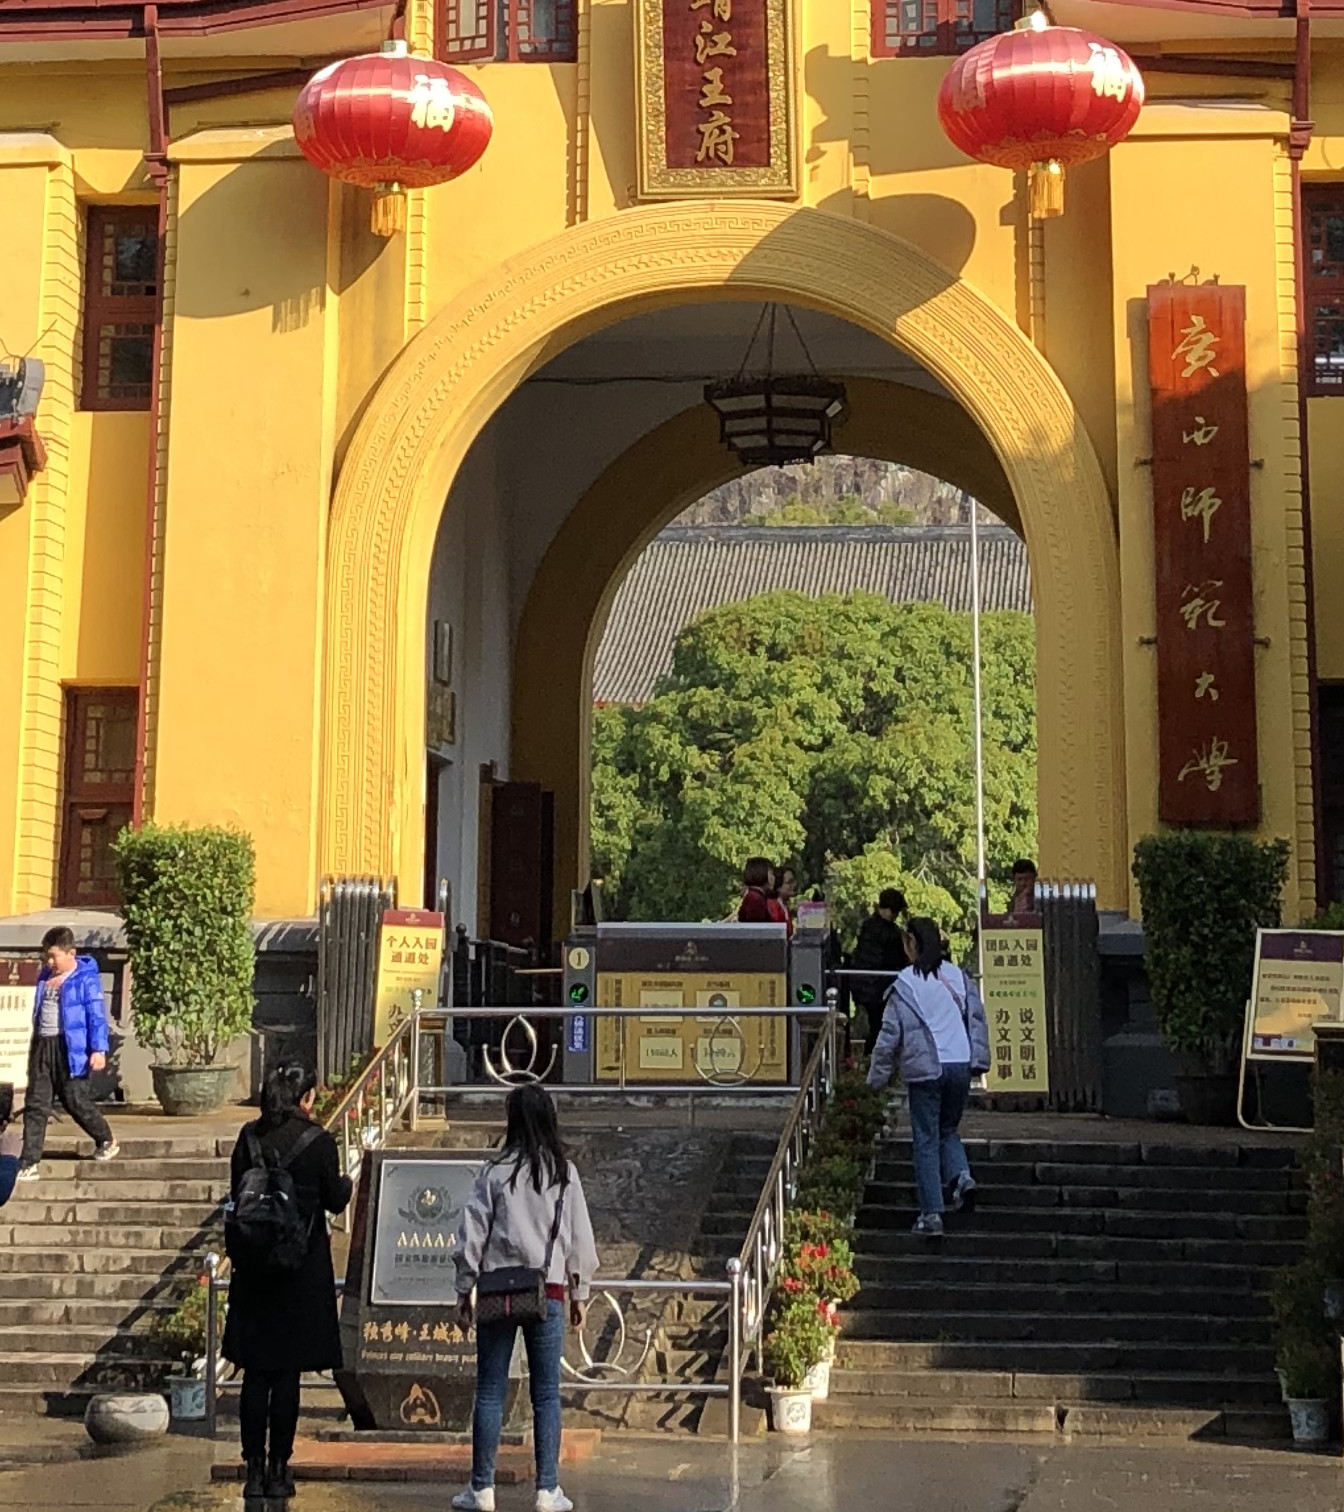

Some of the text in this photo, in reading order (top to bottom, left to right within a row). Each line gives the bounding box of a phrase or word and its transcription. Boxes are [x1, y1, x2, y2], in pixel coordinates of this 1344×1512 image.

[1087, 41, 1131, 103] 福
[409, 74, 455, 133] 福
[386, 935, 438, 950] 个人入园
[391, 951, 430, 965] 通道处
[985, 939, 1038, 952] 团队入园
[993, 954, 1032, 968] 通道处
[994, 1007, 1013, 1081] 办文明事
[1019, 1007, 1037, 1081] 说文明话
